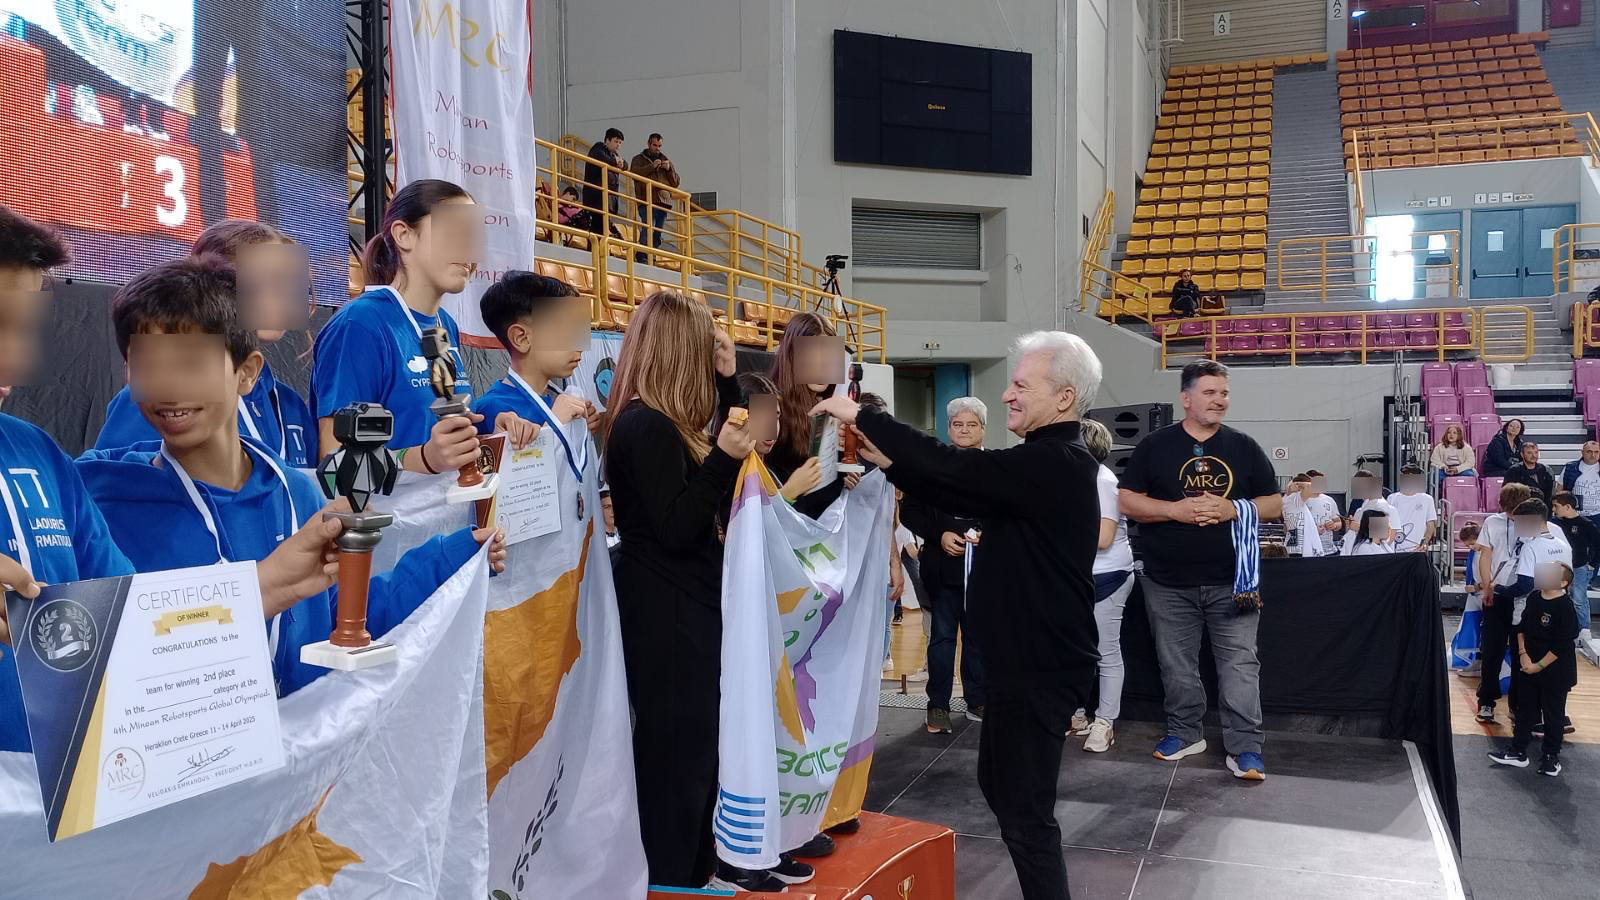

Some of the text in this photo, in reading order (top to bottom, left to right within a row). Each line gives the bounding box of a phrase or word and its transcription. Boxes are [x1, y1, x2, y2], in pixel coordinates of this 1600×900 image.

[1333, 0, 1342, 8] A
[1334, 9, 1341, 18] 2
[1218, 14, 1226, 24] A
[1218, 24, 1226, 34] 3
[411, 0, 512, 72] MRC
[156, 155, 187, 226] 3
[1184, 474, 1228, 489] MRC
[137, 581, 241, 611] CERTIFICATE
[177, 611, 210, 622] OF WINNER
[59, 622, 74, 641] 2
[152, 632, 239, 655] CONGRATULATIONS to the
[145, 668, 236, 696] team for winning 2nd place
[133, 705, 145, 714] the
[213, 683, 239, 696] category
[240, 680, 247, 689] at
[247, 678, 258, 687] the
[113, 725, 127, 735] 4th
[129, 719, 160, 734] Minoan
[161, 706, 208, 723] Robotsports
[208, 698, 233, 712] Global
[144, 738, 172, 752] Heraklion
[172, 734, 188, 744] Crete
[189, 729, 209, 741] Greece
[210, 727, 217, 735] 11
[229, 719, 243, 730] April
[243, 715, 256, 726] 2025
[107, 764, 141, 788] MRC
